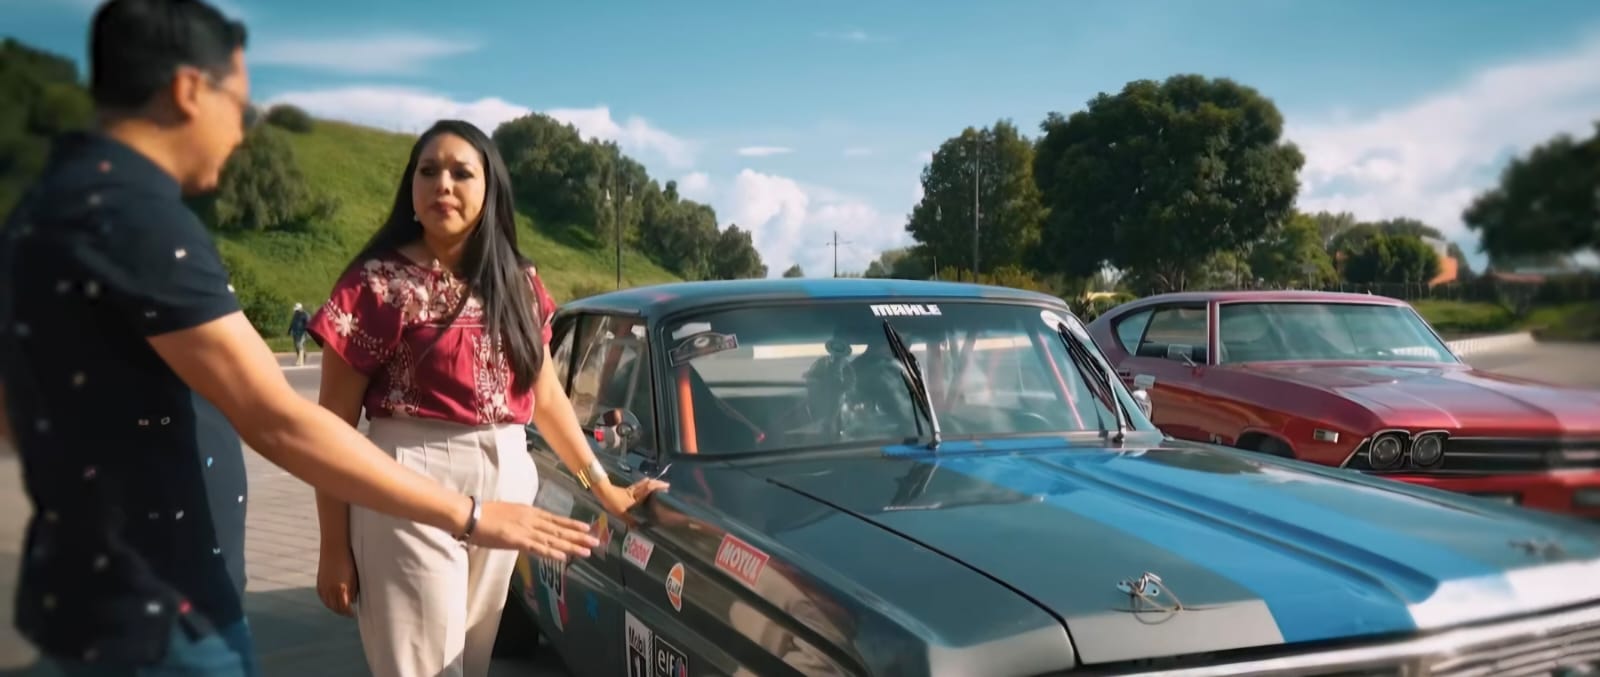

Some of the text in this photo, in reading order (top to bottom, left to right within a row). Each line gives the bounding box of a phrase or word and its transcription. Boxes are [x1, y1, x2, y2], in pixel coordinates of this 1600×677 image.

[870, 304, 942, 317] MAHLE
[719, 541, 762, 579] MOTUL
[658, 649, 675, 677] elf
